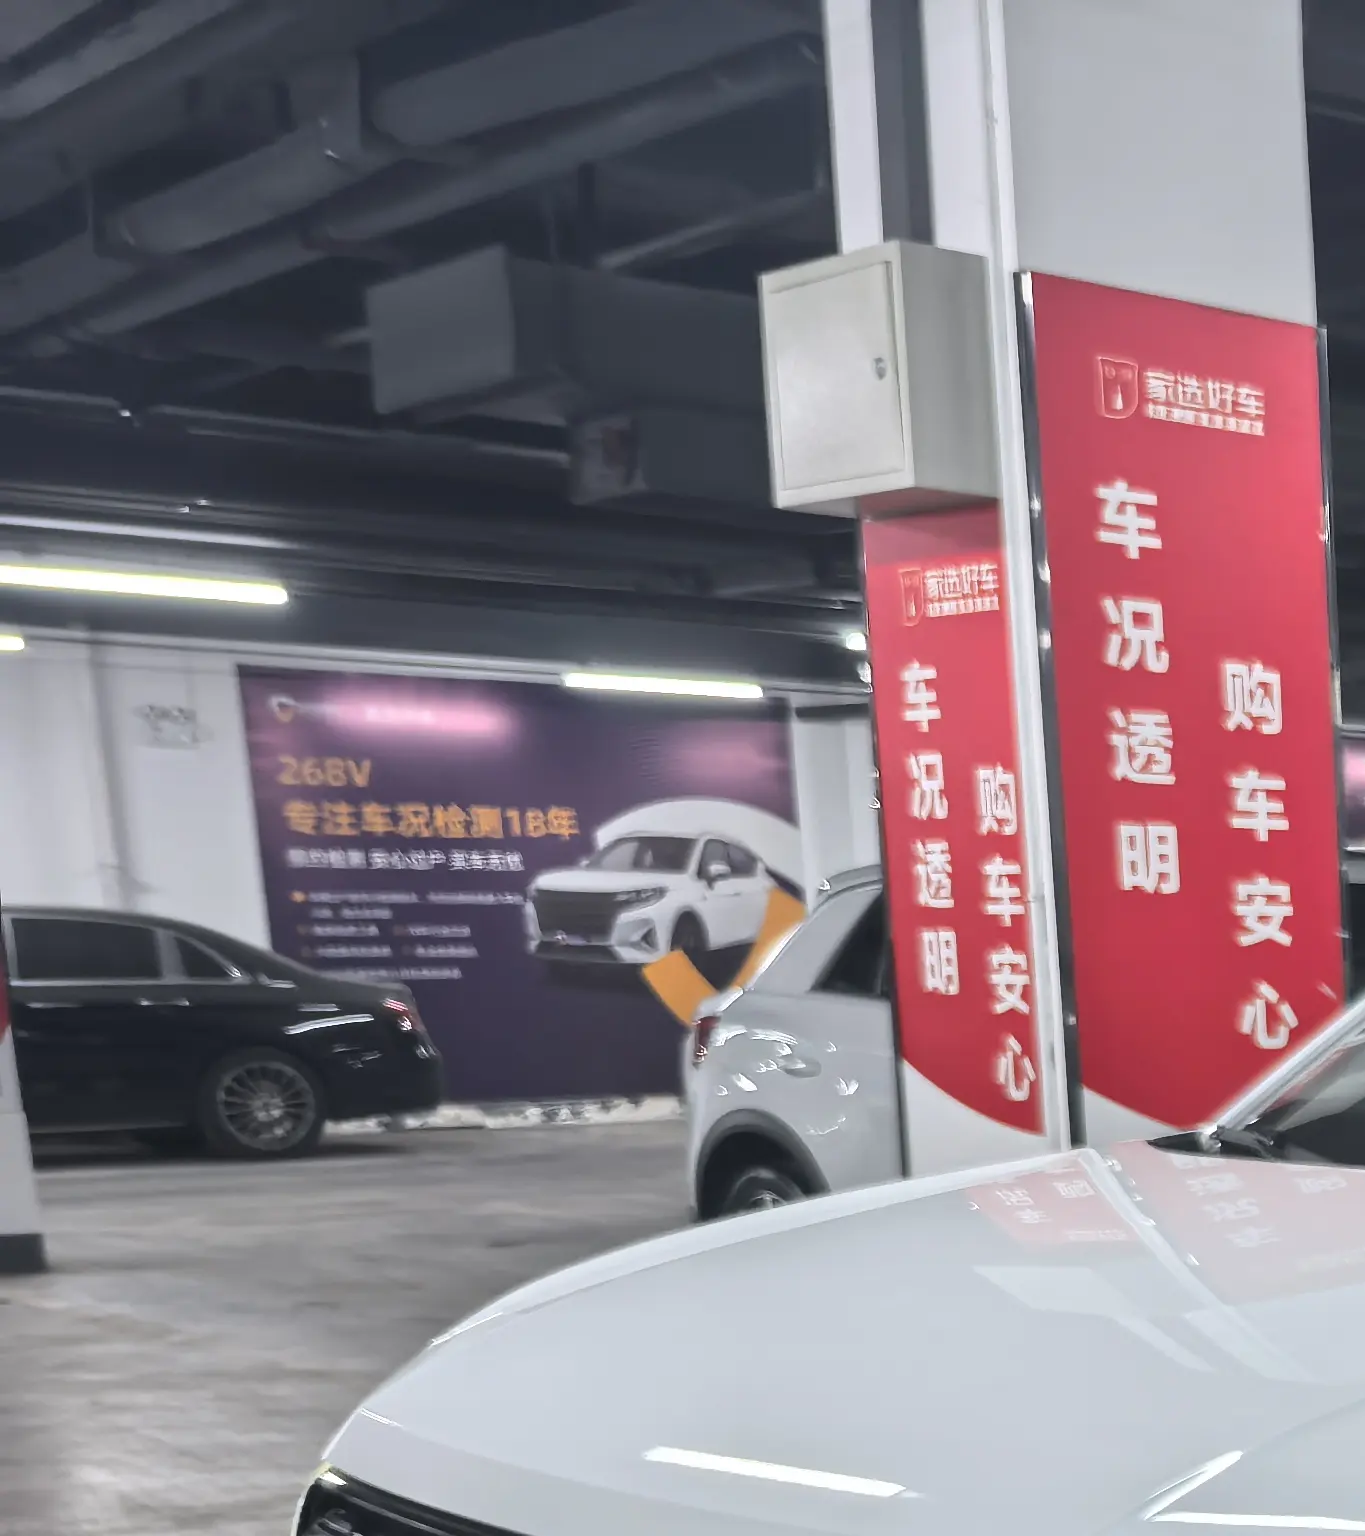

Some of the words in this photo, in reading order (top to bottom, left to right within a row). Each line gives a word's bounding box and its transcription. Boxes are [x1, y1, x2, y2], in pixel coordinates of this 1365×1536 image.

[900, 659, 959, 996] 车况透明
[1096, 479, 1180, 895] 车况透明
[1222, 659, 1299, 1051] 购车安心
[976, 765, 1037, 1102] 购车安心
